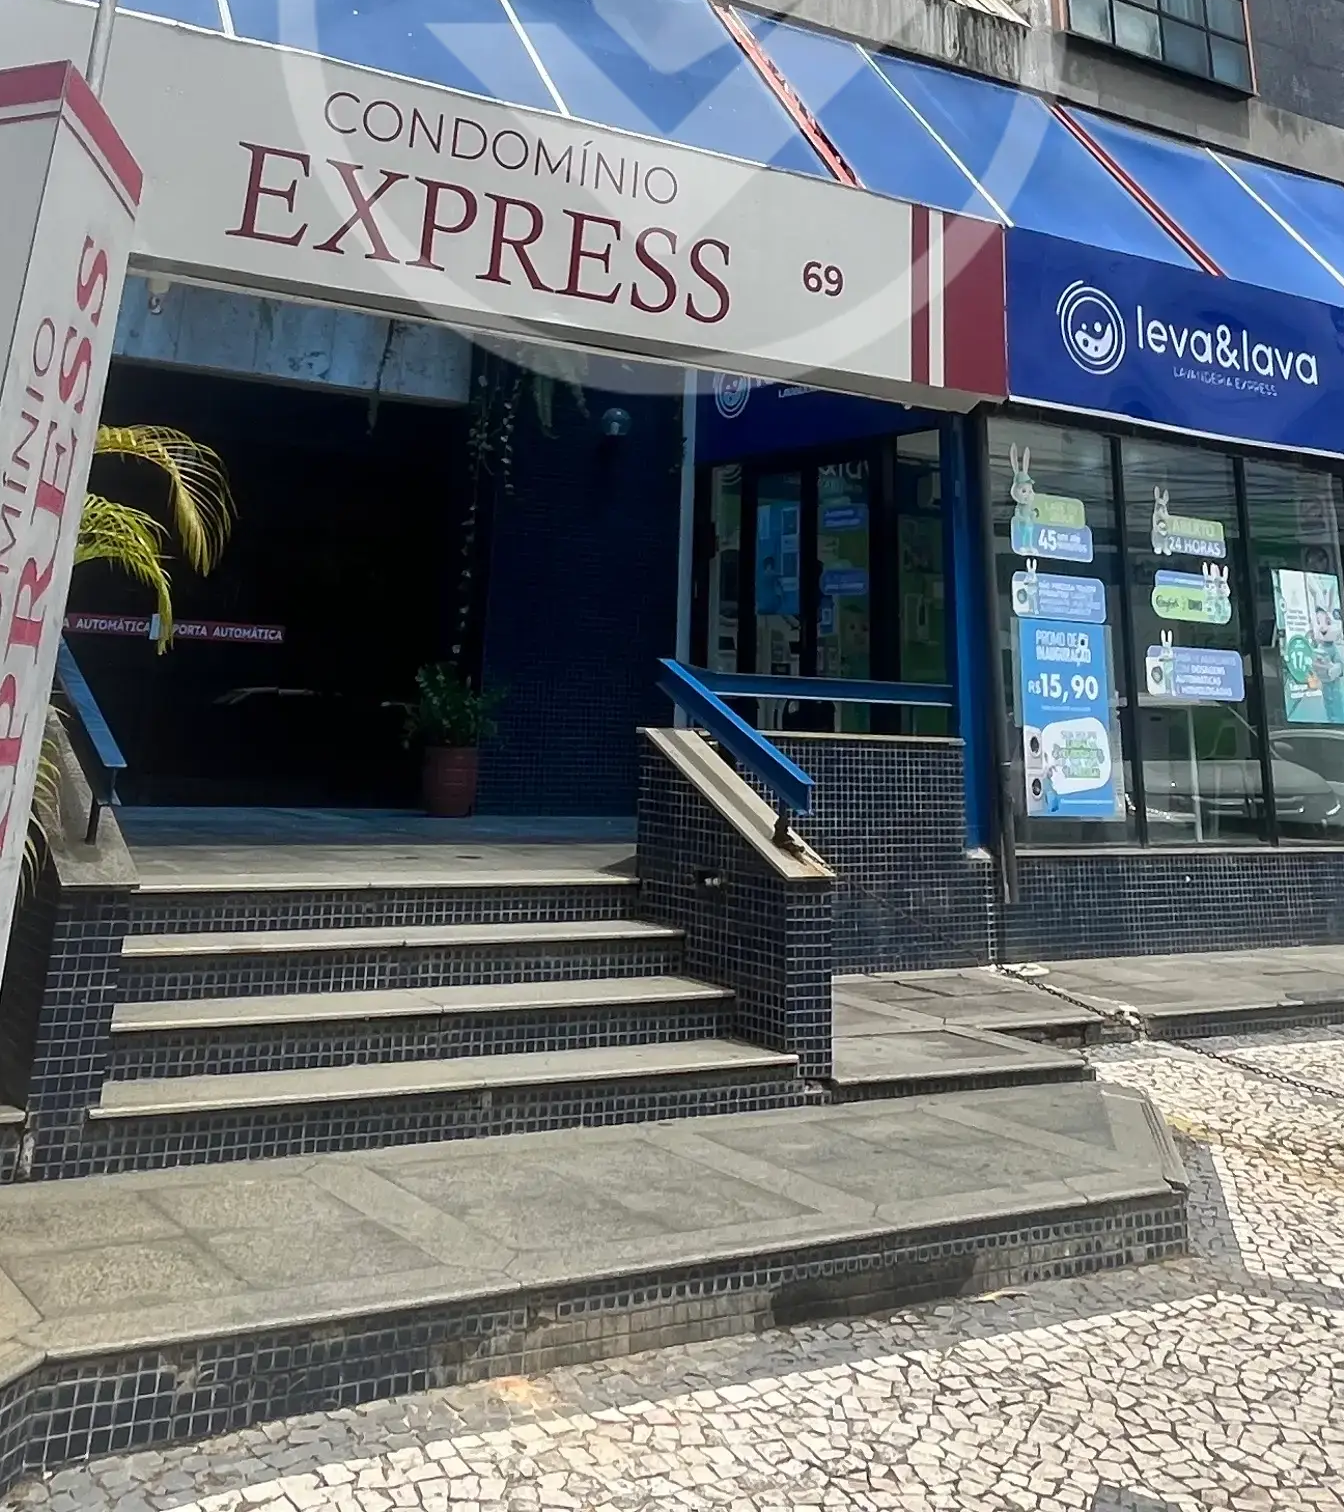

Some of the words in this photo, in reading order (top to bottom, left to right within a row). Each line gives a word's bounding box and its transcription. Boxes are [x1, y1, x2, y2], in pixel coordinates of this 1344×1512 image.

[324, 91, 677, 205] CONDOMÍNIO
[224, 141, 730, 324] EXPRESS
[802, 261, 844, 296] 69
[1136, 305, 1319, 385] leva&lava
[1038, 528, 1056, 551] 45
[1168, 536, 1182, 552] 24
[1184, 537, 1221, 555] HORAS
[75, 617, 150, 633] AUTOMÁTICA
[172, 623, 207, 637] PORTA
[212, 625, 283, 641] AUTOMÁTICA
